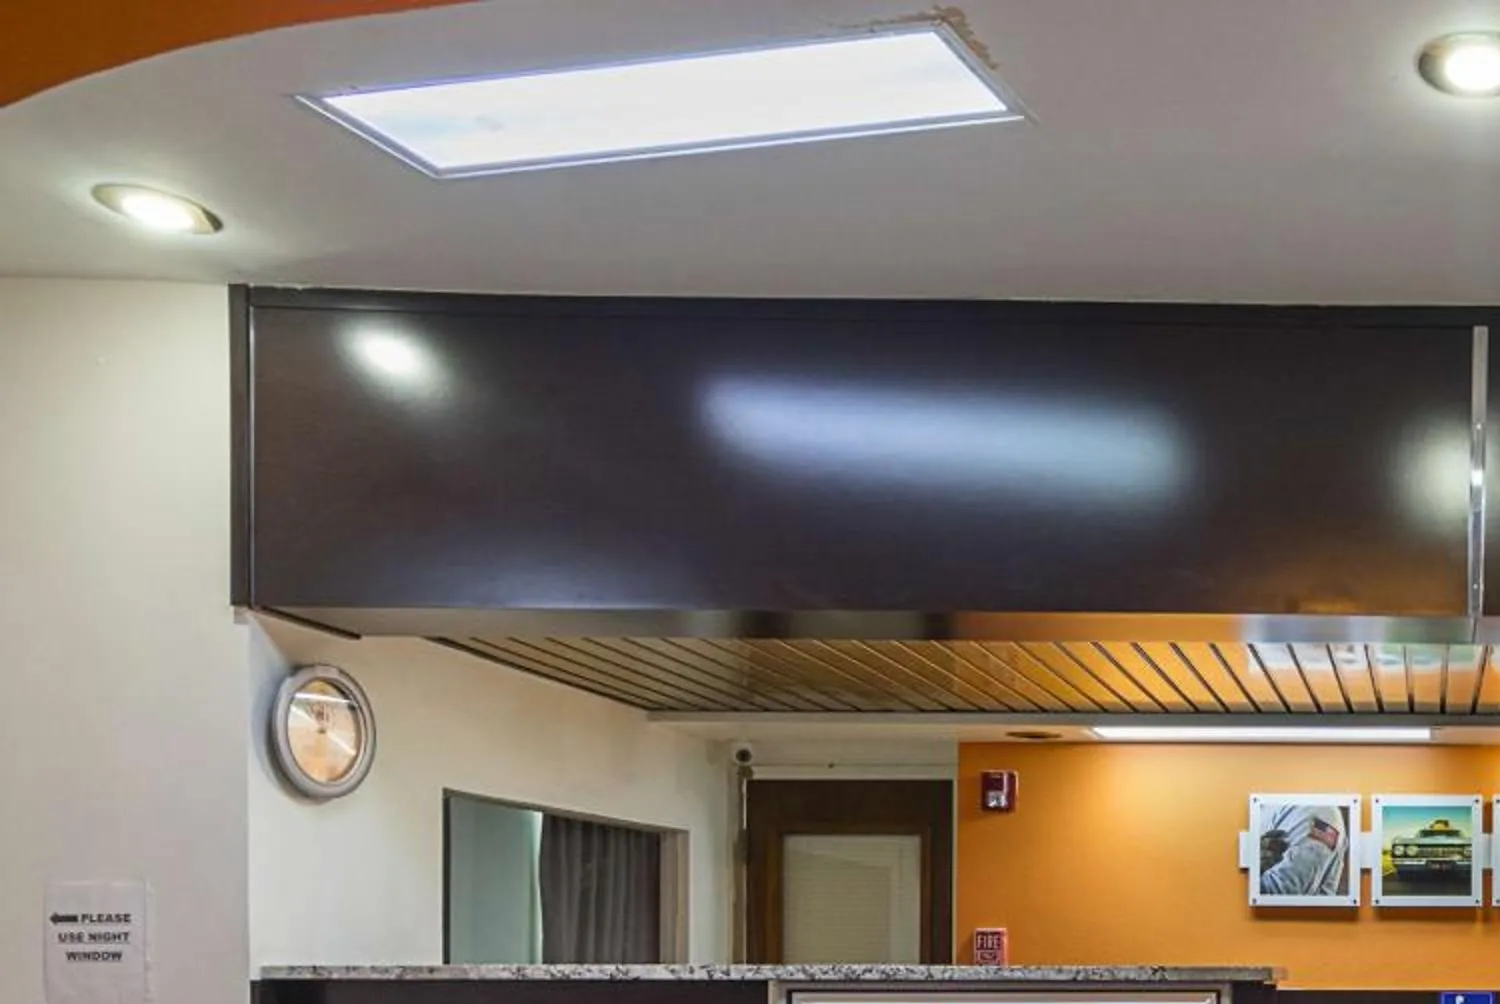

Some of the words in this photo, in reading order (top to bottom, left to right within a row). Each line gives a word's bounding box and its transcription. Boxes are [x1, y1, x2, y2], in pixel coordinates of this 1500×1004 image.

[80, 913, 132, 924] PLEASE
[57, 932, 84, 943] USE
[88, 931, 130, 944] NIGHT
[977, 935, 1000, 949] FIRE
[65, 951, 123, 962] WINDOW
